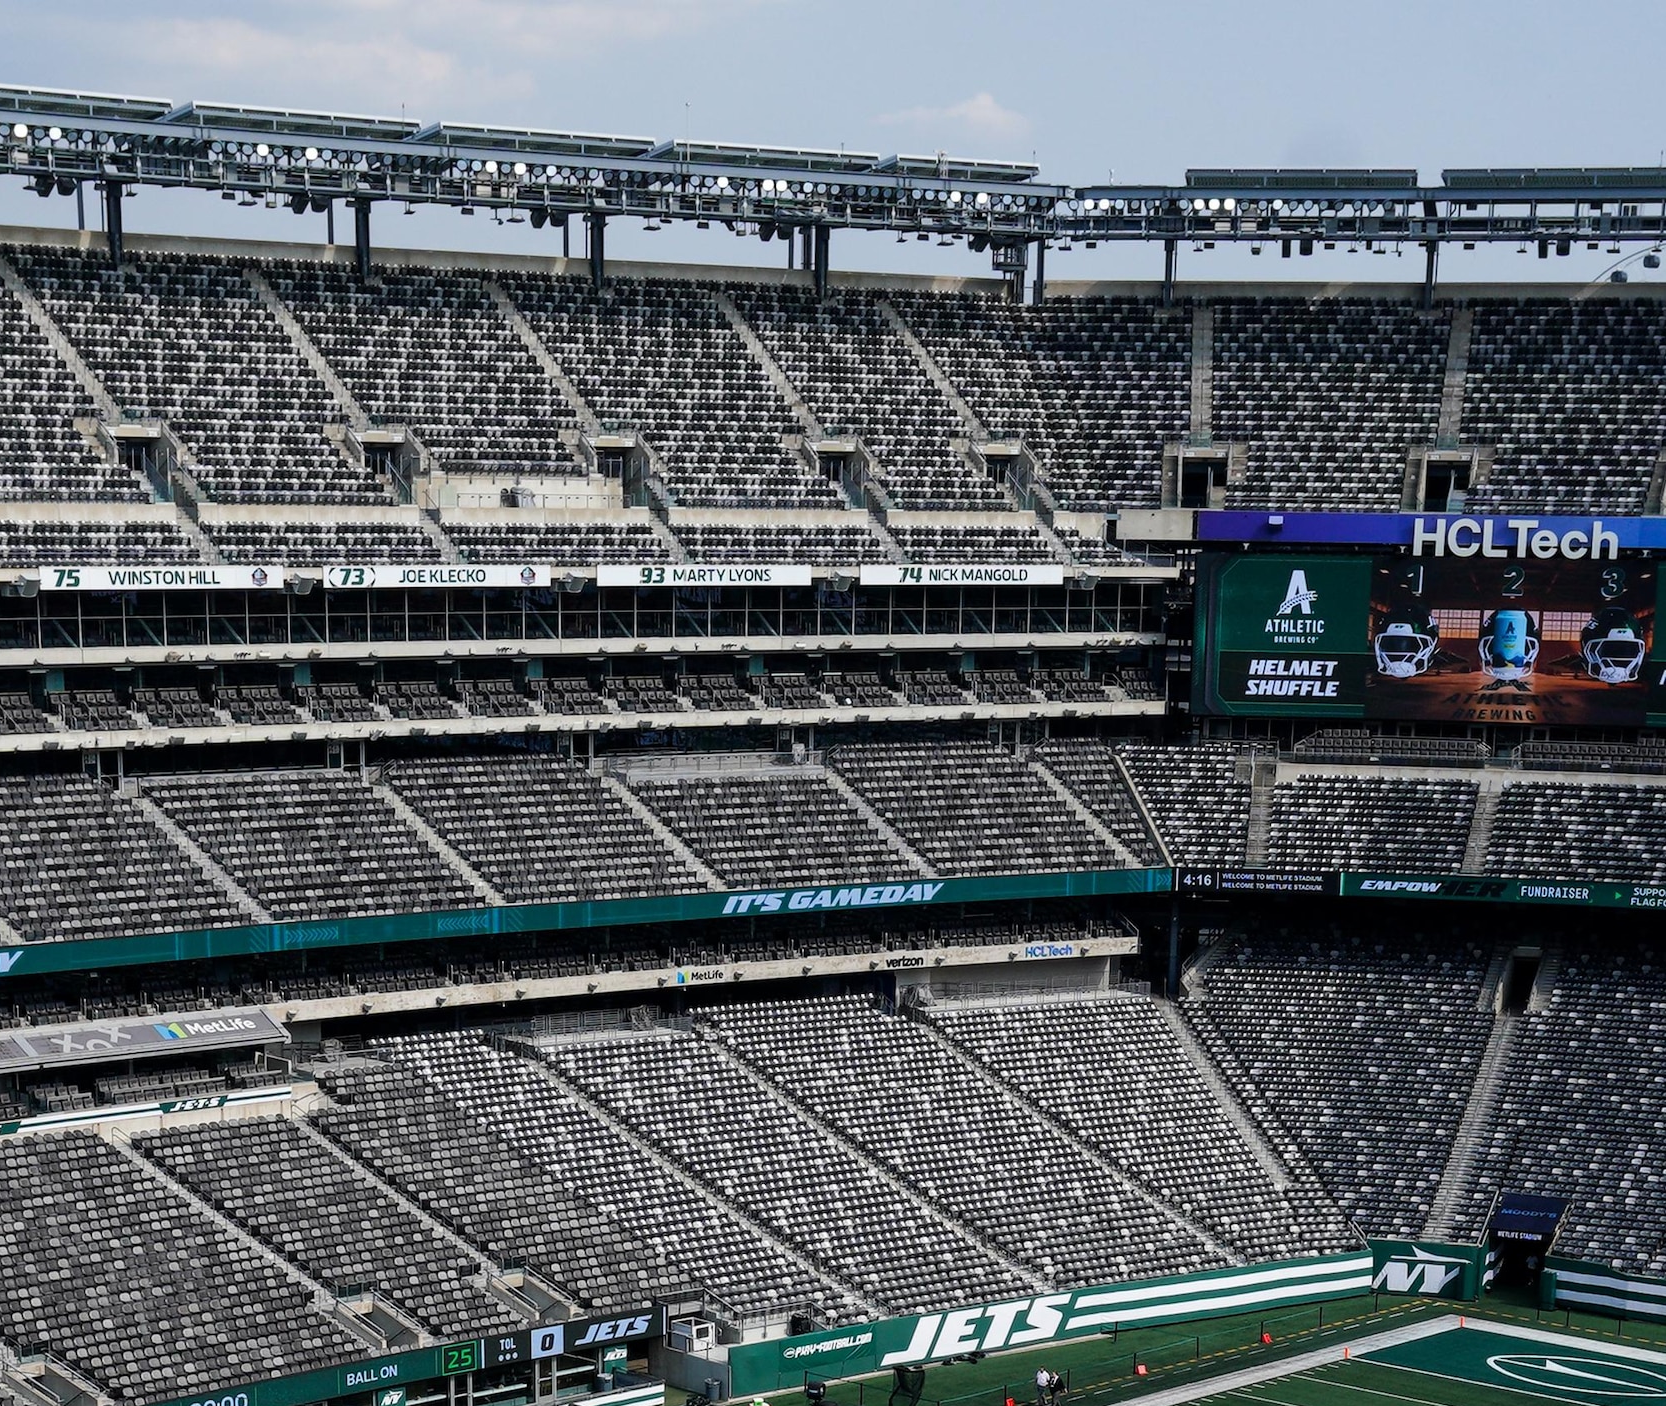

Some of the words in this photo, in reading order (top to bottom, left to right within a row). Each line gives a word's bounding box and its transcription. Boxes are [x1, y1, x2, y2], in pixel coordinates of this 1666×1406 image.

[1413, 518, 1619, 560] HCLTech
[53, 569, 81, 588] 75
[108, 570, 184, 585] WINSTON
[189, 569, 220, 584] HILL
[339, 568, 365, 585] 73
[399, 569, 425, 583] JOE
[430, 569, 486, 583] KLECKO
[640, 567, 665, 584] 93
[673, 569, 726, 582] MARTY
[729, 569, 772, 582] LYONS
[898, 567, 922, 583] 74
[929, 568, 959, 580] NICK
[964, 568, 1028, 581] MANGOLD
[1502, 566, 1526, 598] 2
[1600, 568, 1629, 600] 3
[1265, 620, 1324, 634] ATHLETIC
[1249, 660, 1338, 676] HELMET
[1245, 680, 1340, 697] SHUFFLE
[1184, 874, 1212, 886] 4:16
[1222, 873, 1254, 881] WELCOME
[1222, 882, 1254, 890] WELCOME
[1520, 885, 1589, 899] FUNDRAISER
[722, 893, 787, 914] IT'S
[788, 883, 944, 909] GAMEDAY
[1630, 898, 1655, 907] FLAG
[1025, 944, 1072, 958] HCLTech
[886, 956, 924, 968] verizon
[691, 970, 724, 981] MetLife
[185, 1018, 256, 1035] MetLife
[499, 1337, 516, 1350] TOL
[541, 1333, 555, 1352] 0
[574, 1314, 653, 1346] JETS
[880, 1293, 1072, 1366] JETS
[346, 1369, 378, 1386] BALL
[380, 1364, 398, 1379] ON
[447, 1348, 472, 1368] 25
